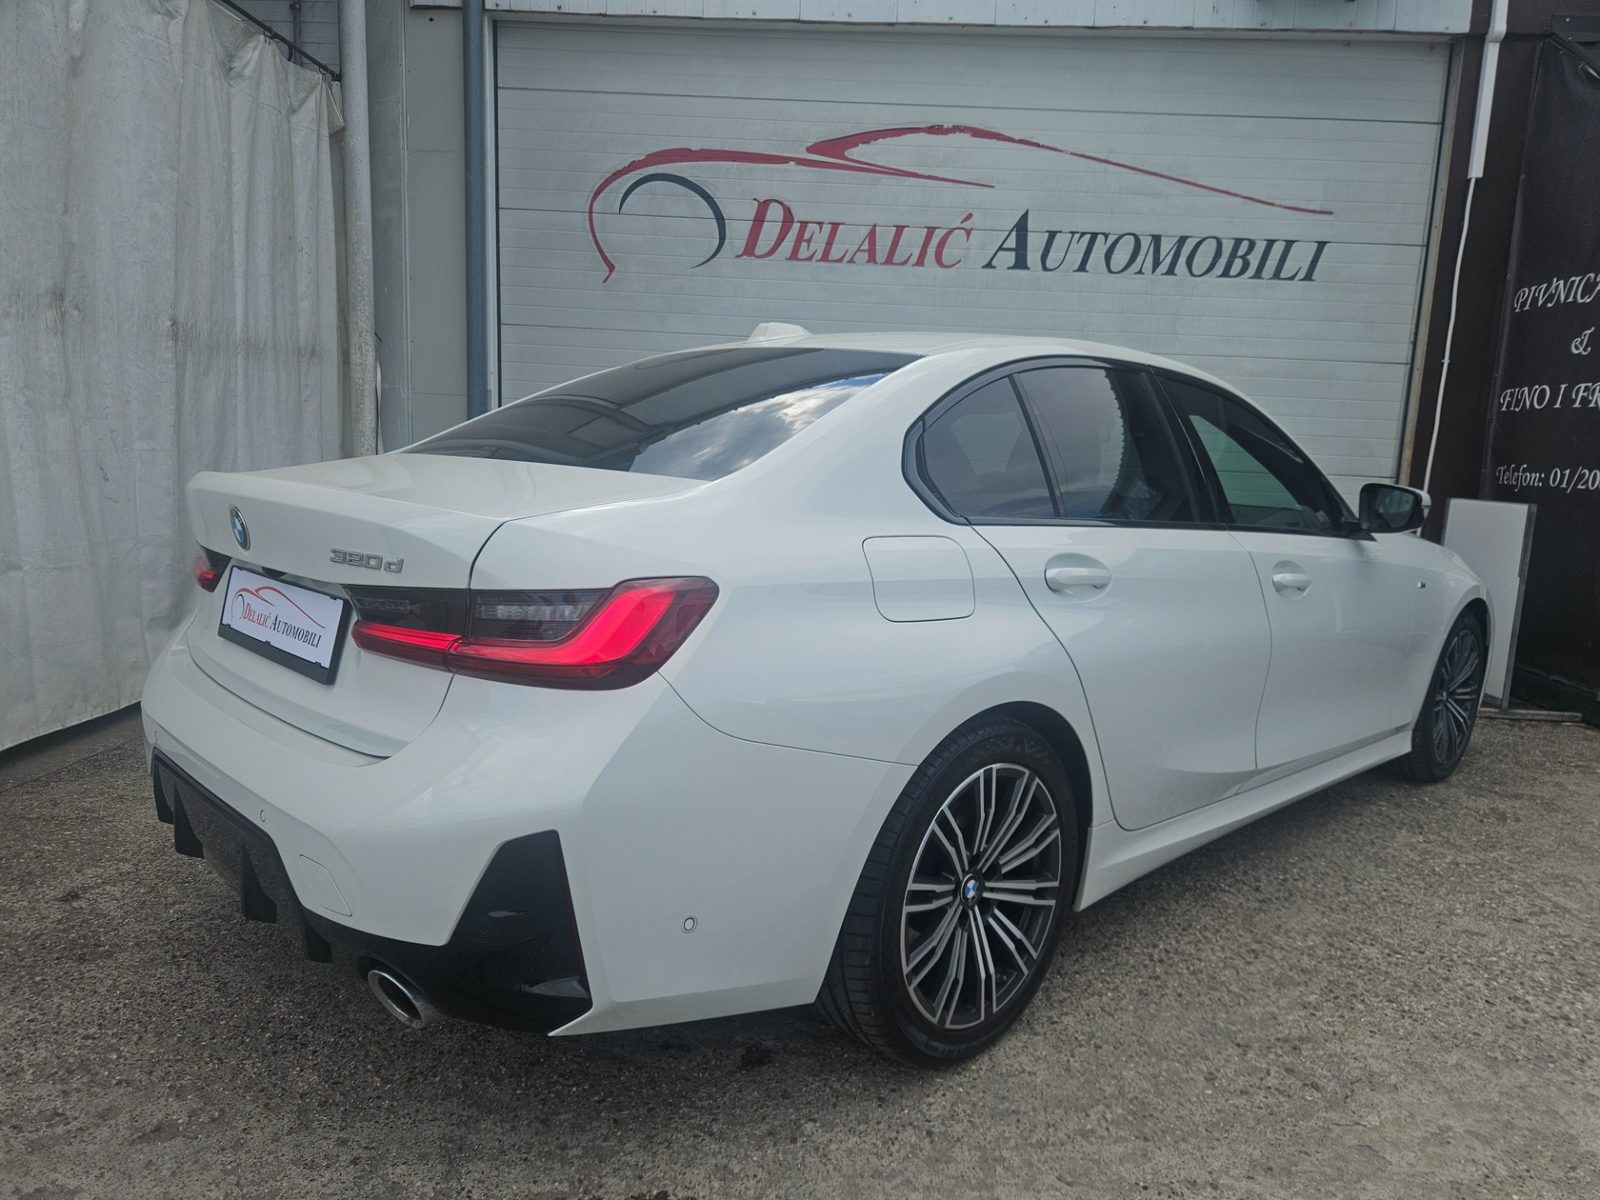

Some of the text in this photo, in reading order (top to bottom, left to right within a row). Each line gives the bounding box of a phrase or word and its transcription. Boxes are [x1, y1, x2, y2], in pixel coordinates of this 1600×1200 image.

[736, 197, 1332, 282] DELALIĆ AUTOMOBILI
[1571, 327, 1595, 355] &
[1500, 384, 1550, 412] FINO
[1553, 383, 1568, 408] I
[1496, 464, 1600, 494] Telefon: 01/20
[243, 602, 322, 648] DELALIĆ AUTOMOBILI
